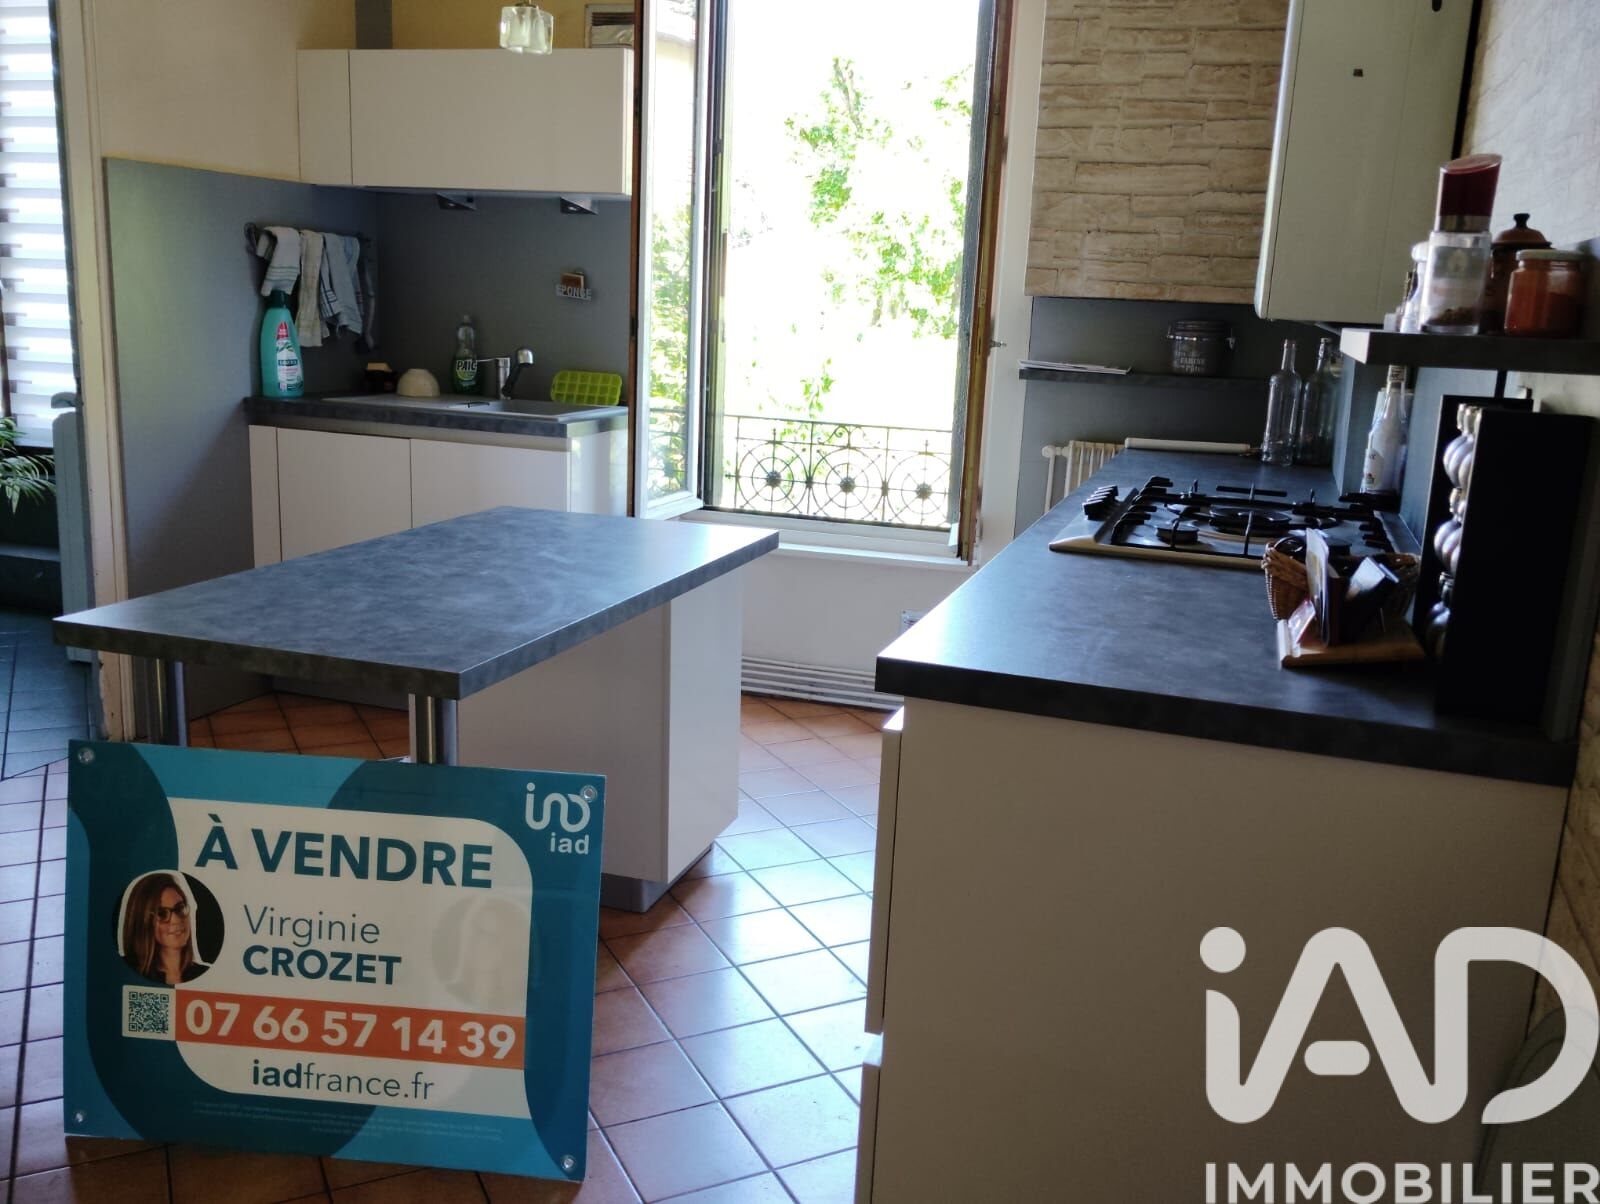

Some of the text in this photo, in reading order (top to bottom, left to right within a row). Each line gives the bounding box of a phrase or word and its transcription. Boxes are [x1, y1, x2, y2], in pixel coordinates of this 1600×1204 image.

[457, 360, 478, 371] PAIC
[194, 813, 493, 889] À VENDRE
[550, 832, 590, 855] iad
[243, 904, 380, 948] Virginie
[242, 944, 402, 985] CROZET
[185, 999, 516, 1060] 07 66 57 14 39
[251, 1059, 435, 1099] iadfrance.fr
